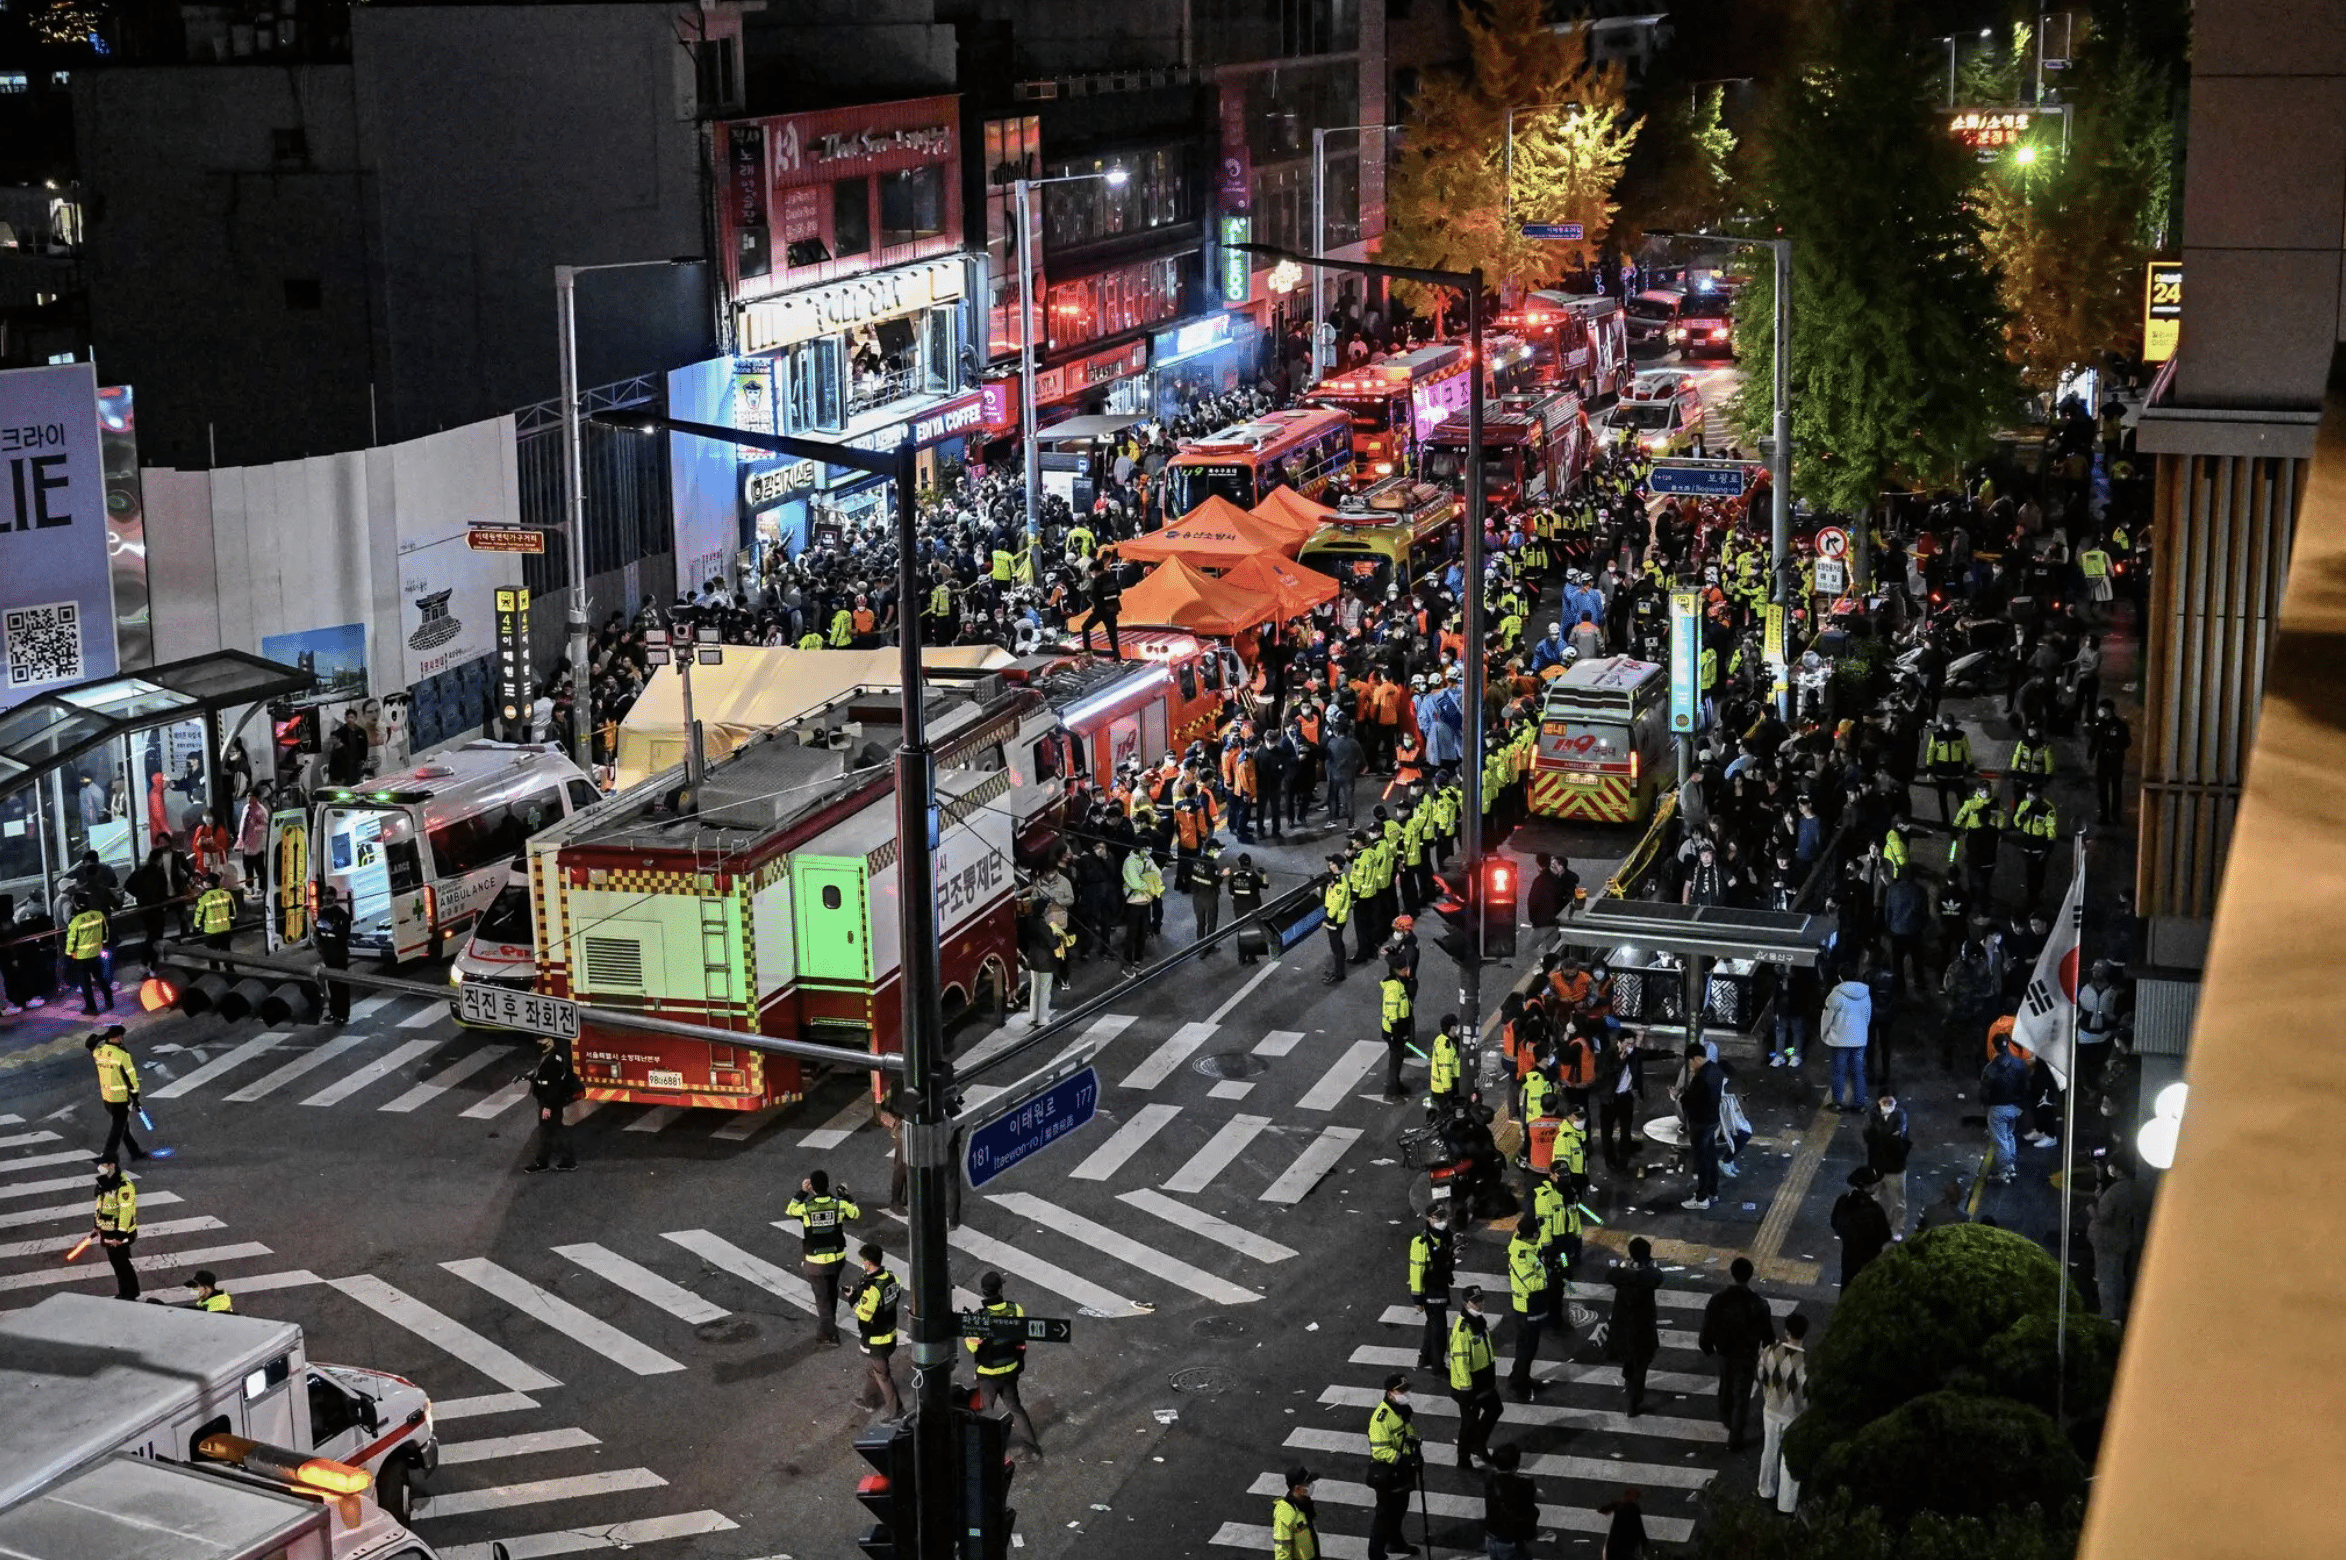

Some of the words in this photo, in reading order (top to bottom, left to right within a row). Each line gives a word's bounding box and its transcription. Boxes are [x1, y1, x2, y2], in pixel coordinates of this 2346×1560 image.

[916, 414, 945, 444] EDIYA
[945, 402, 981, 432] COFFEE
[1708, 473, 1740, 484] 보광로
[0, 453, 72, 533] IE
[1695, 484, 1740, 495] Bogwang-ro
[1182, 531, 1236, 542] 용산소방서
[502, 614, 511, 626] 4
[502, 635, 514, 678] 이태원
[1552, 734, 1597, 755] 119
[440, 876, 496, 908] AMBULANCE
[1769, 953, 1795, 962] 용산구
[465, 988, 497, 1020] 직진
[503, 994, 518, 1024] 후
[525, 1000, 575, 1035] 좌회전
[586, 1051, 619, 1060] 서울특별시
[620, 1054, 660, 1063] 소방재난본부
[1009, 1096, 1056, 1135] 이태원로
[1076, 1084, 1093, 1109] 177
[972, 1145, 989, 1170] 181
[993, 1135, 1039, 1170] Itaewon-ro
[962, 1314, 990, 1326] 화장실
